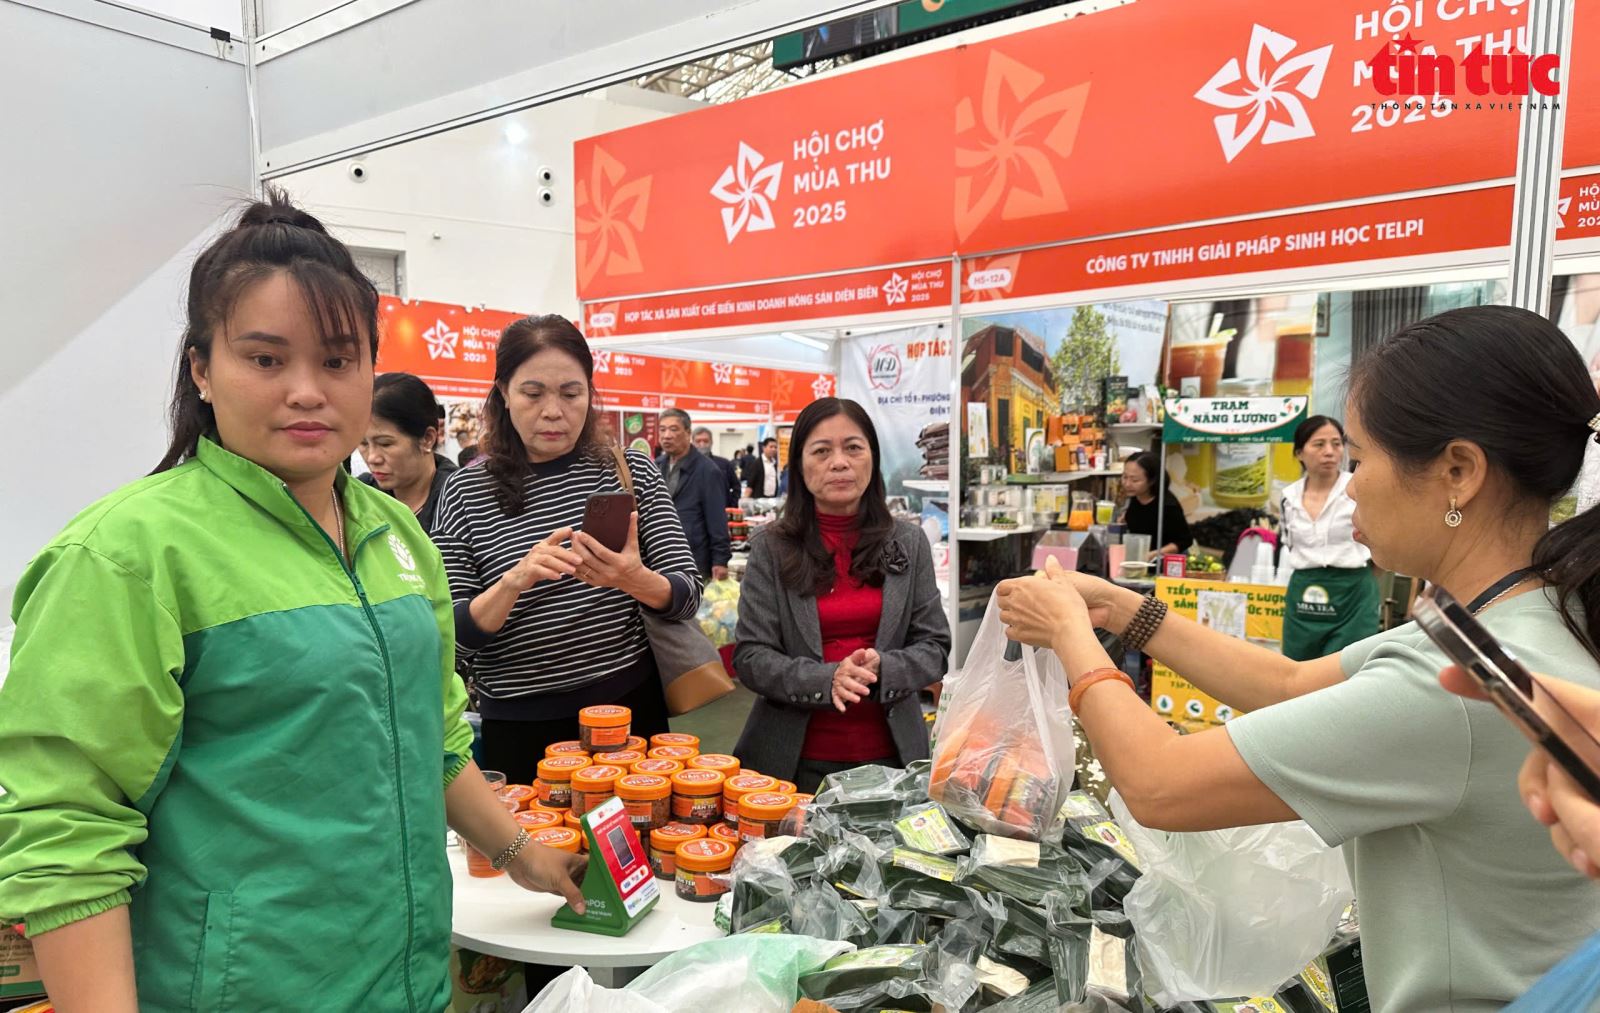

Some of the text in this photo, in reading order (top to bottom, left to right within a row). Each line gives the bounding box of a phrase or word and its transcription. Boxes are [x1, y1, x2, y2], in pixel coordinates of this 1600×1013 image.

[1351, 92, 1453, 133] 2025
[793, 119, 885, 166] HỘI CHỢ
[793, 157, 891, 195] MÙA THU
[793, 200, 847, 228] 2025
[1085, 218, 1424, 274] CÔNG TY TNHH GIẢI PHÁP SINH HỌC TELPI
[736, 300, 756, 314] KINH
[757, 296, 786, 311] DOANH
[788, 292, 814, 307] NÔNG
[463, 352, 487, 363] 2025
[1193, 412, 1278, 425] NĂNG LƯỢNG
[1211, 401, 1249, 412] TRẠM
